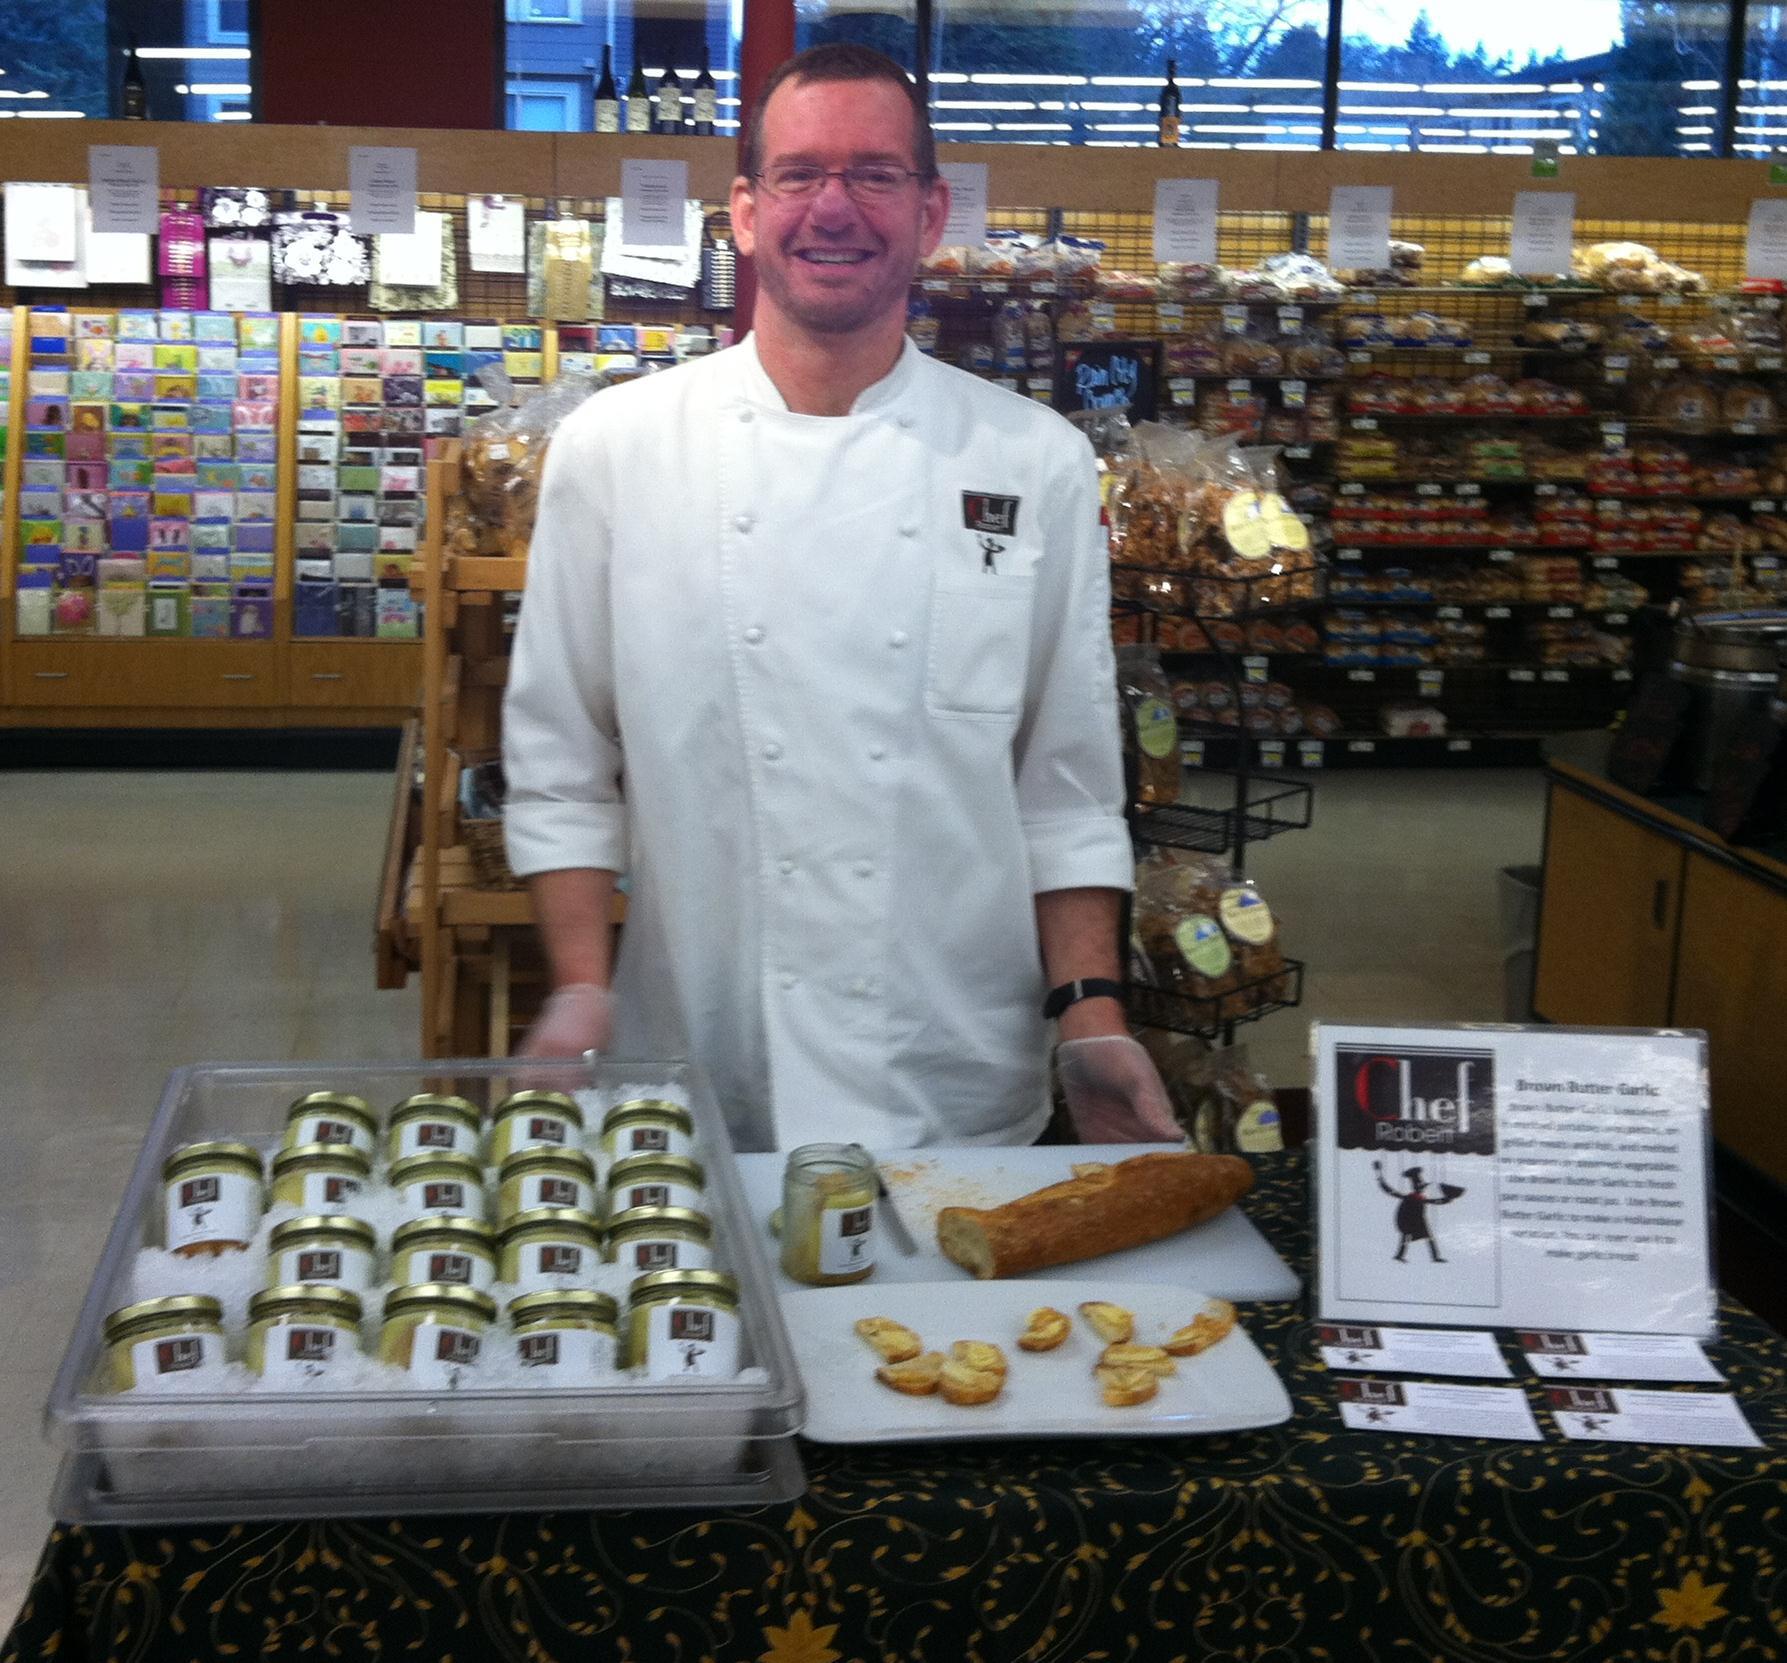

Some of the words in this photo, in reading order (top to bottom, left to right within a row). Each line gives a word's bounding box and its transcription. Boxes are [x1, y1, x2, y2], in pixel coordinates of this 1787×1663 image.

[1355, 1055, 1475, 1134] Chef
[1516, 1079, 1562, 1093] Brown
[1567, 1081, 1612, 1094] Butter
[1617, 1082, 1660, 1097] Garlic
[1375, 1121, 1455, 1144] Robert
